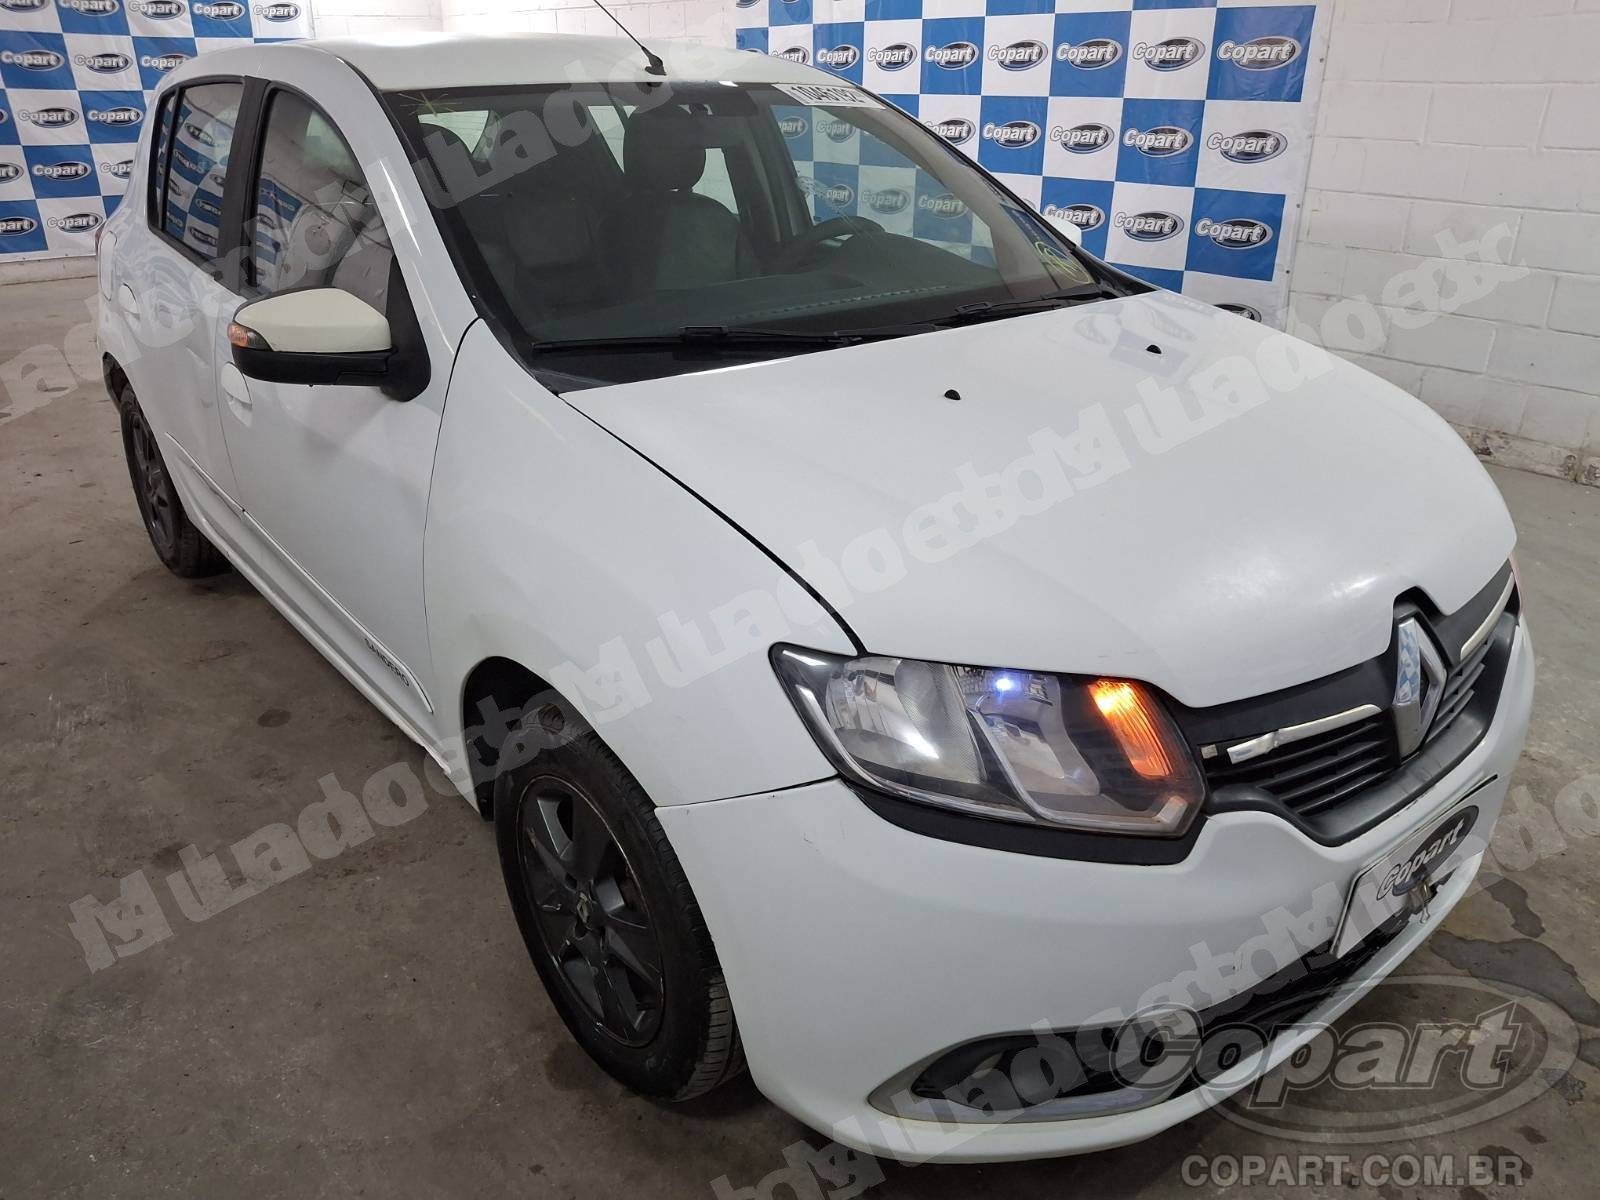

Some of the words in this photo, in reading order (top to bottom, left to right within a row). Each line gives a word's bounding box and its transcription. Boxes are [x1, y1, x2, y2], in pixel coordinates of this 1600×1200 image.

[129, 1, 180, 15] Copart
[193, 3, 240, 18] Copart
[253, 4, 296, 17] Copart
[1, 51, 58, 66] Copart
[817, 47, 854, 64] Copart
[867, 47, 910, 65] Copart
[925, 45, 972, 66] Copart
[987, 44, 1039, 64] Copart
[1056, 42, 1114, 64] Copart
[1132, 42, 1195, 64] Copart
[1216, 39, 1293, 64] Copart
[74, 54, 125, 68] Copart
[18, 110, 71, 125] Copart
[87, 109, 138, 124] Copart
[982, 122, 1035, 142] Copart
[1050, 126, 1105, 145] Copart
[1122, 127, 1185, 150] Copart
[1206, 131, 1279, 155] Copart
[32, 163, 85, 179] Copart
[918, 194, 965, 212] Copart
[47, 215, 95, 230] Copart
[1113, 211, 1175, 235] Copart
[1195, 217, 1266, 243] Copart
[1376, 817, 1465, 901] Copart
